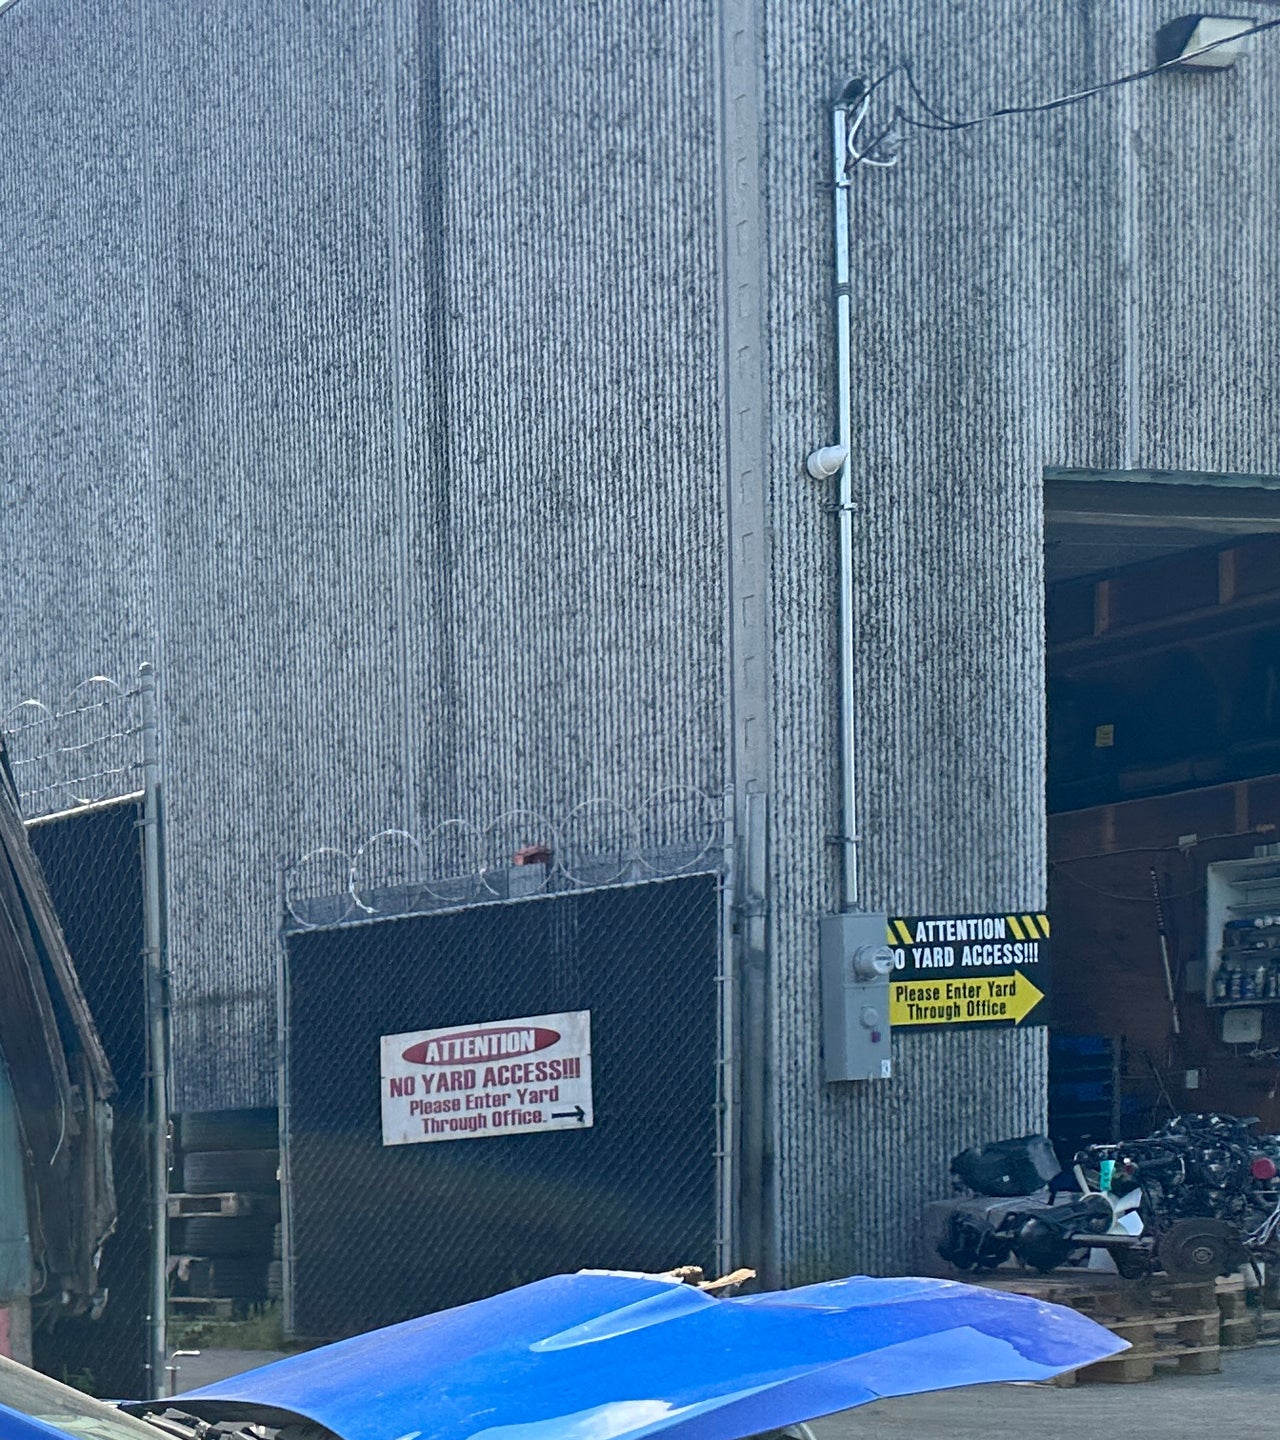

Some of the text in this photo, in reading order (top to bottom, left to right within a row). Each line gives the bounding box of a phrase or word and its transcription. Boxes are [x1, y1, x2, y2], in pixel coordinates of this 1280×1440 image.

[915, 917, 1006, 943] ATTENTION
[894, 942, 1039, 970] O YARD ACCESS!!!
[896, 980, 1016, 1002] Please Enter Yard
[907, 1000, 1007, 1021] Through Office
[424, 1029, 536, 1064] ATTENTION
[390, 1057, 581, 1098] NO YARD ACCESS!!!
[410, 1085, 559, 1116] Please Enter Yard
[422, 1113, 487, 1135] Through
